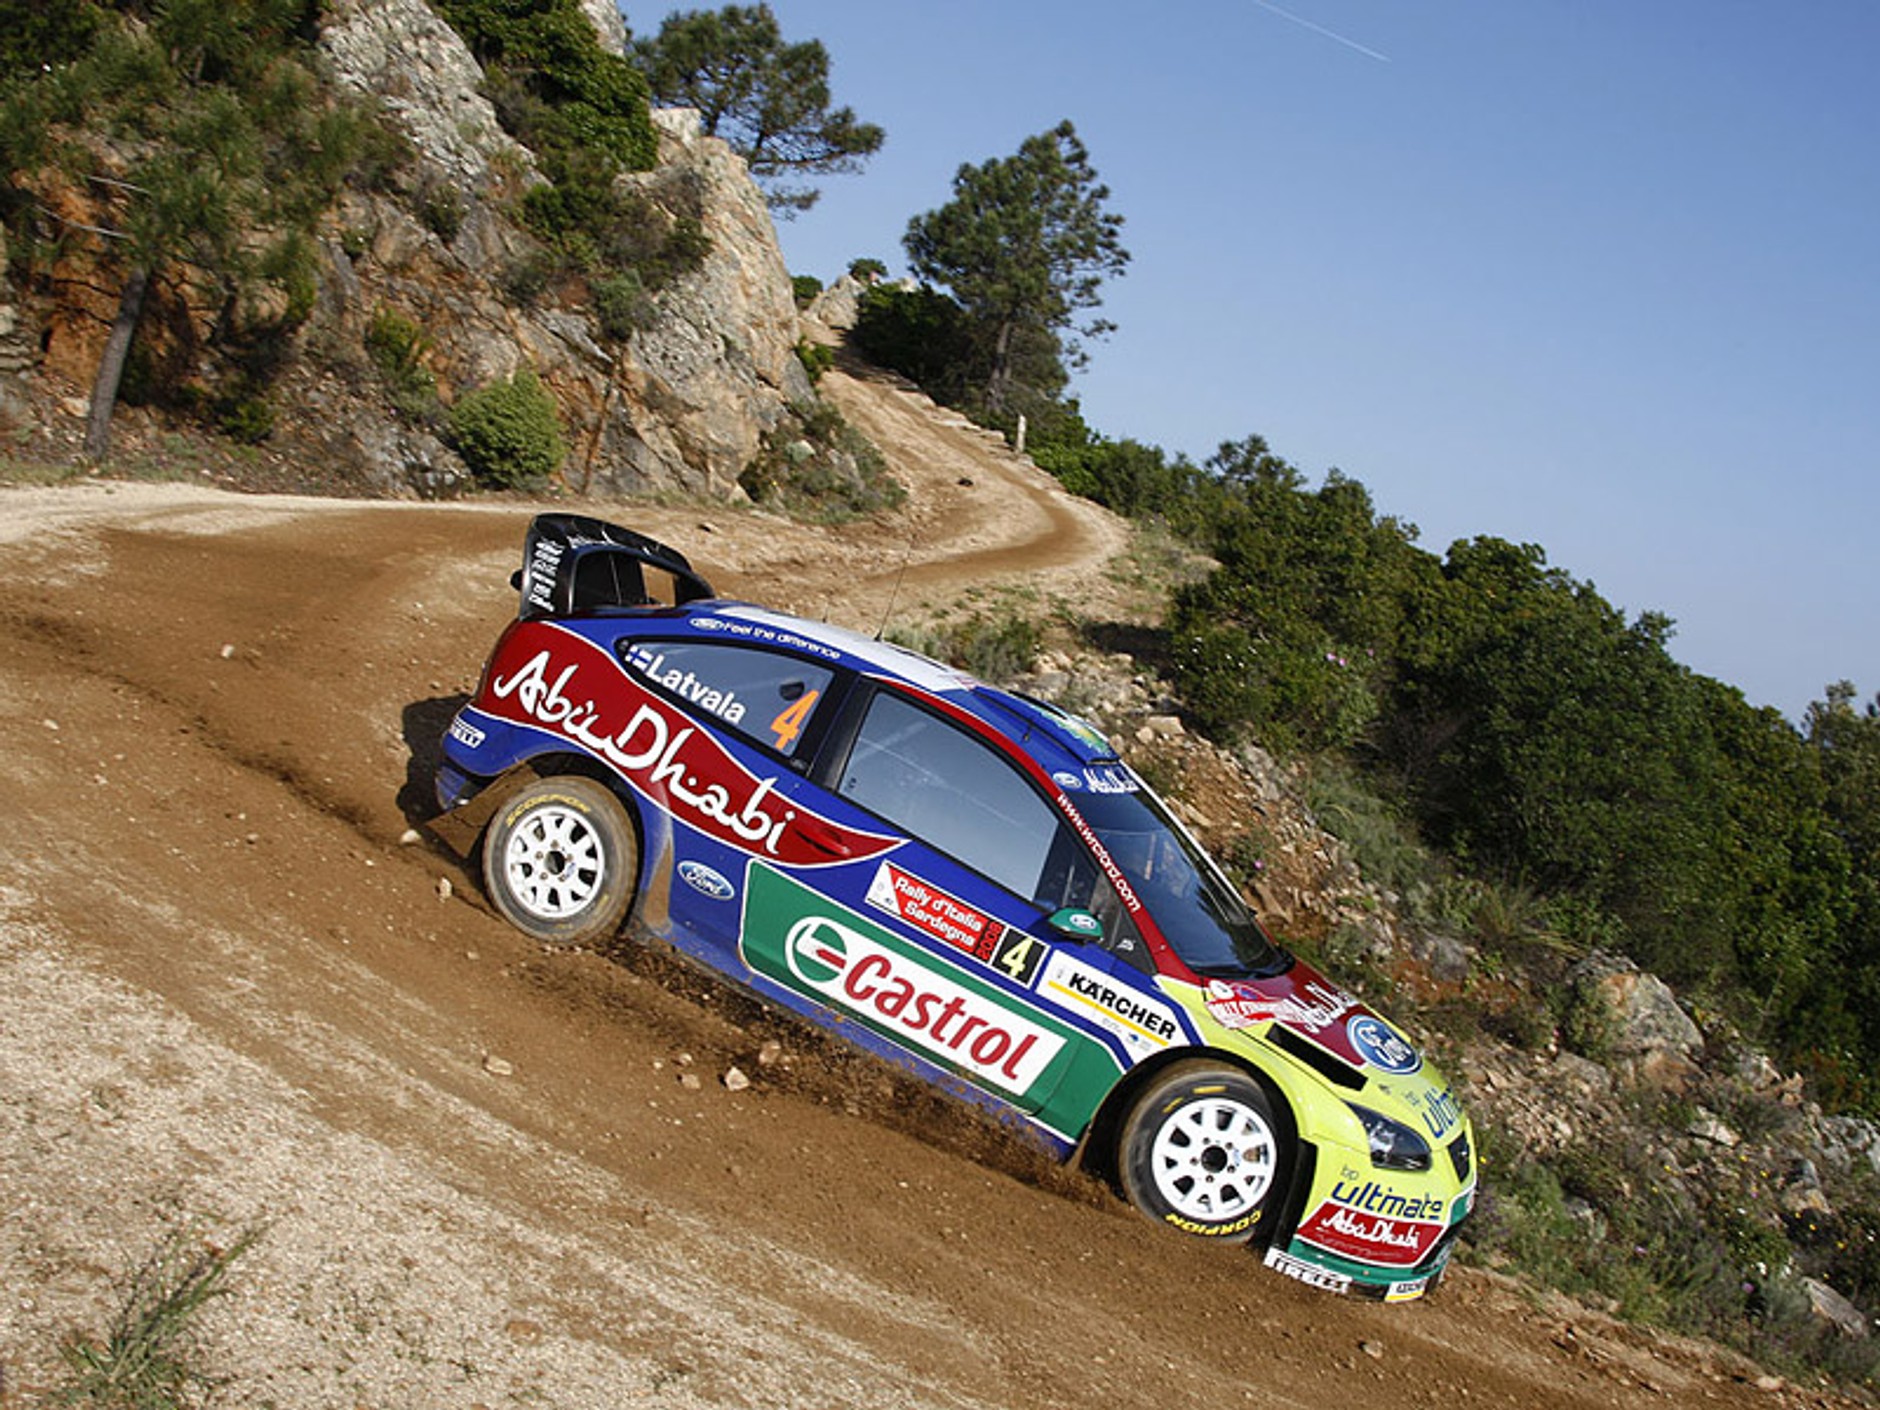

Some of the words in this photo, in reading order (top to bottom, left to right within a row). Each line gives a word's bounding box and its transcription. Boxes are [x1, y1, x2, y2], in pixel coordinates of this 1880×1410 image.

[723, 622, 752, 635] Feel
[753, 628, 775, 641] the
[777, 633, 841, 660] difference
[646, 655, 747, 725] Latvala
[770, 690, 819, 750] 4
[603, 703, 796, 854] Dhabi
[1057, 793, 1141, 912] www.wrcford.com
[683, 864, 726, 896] Ford
[895, 877, 932, 906] Rally
[932, 896, 982, 932] d'Italia
[905, 901, 976, 948] Sardegna
[975, 922, 1003, 961] 2008
[1001, 936, 1034, 978] 4
[844, 954, 1038, 1080] Castrol
[1069, 972, 1177, 1040] KÄRCHER
[1355, 1022, 1414, 1068] Ford
[1331, 1181, 1443, 1221] ultimate
[1369, 1219, 1420, 1249] Dhabi
